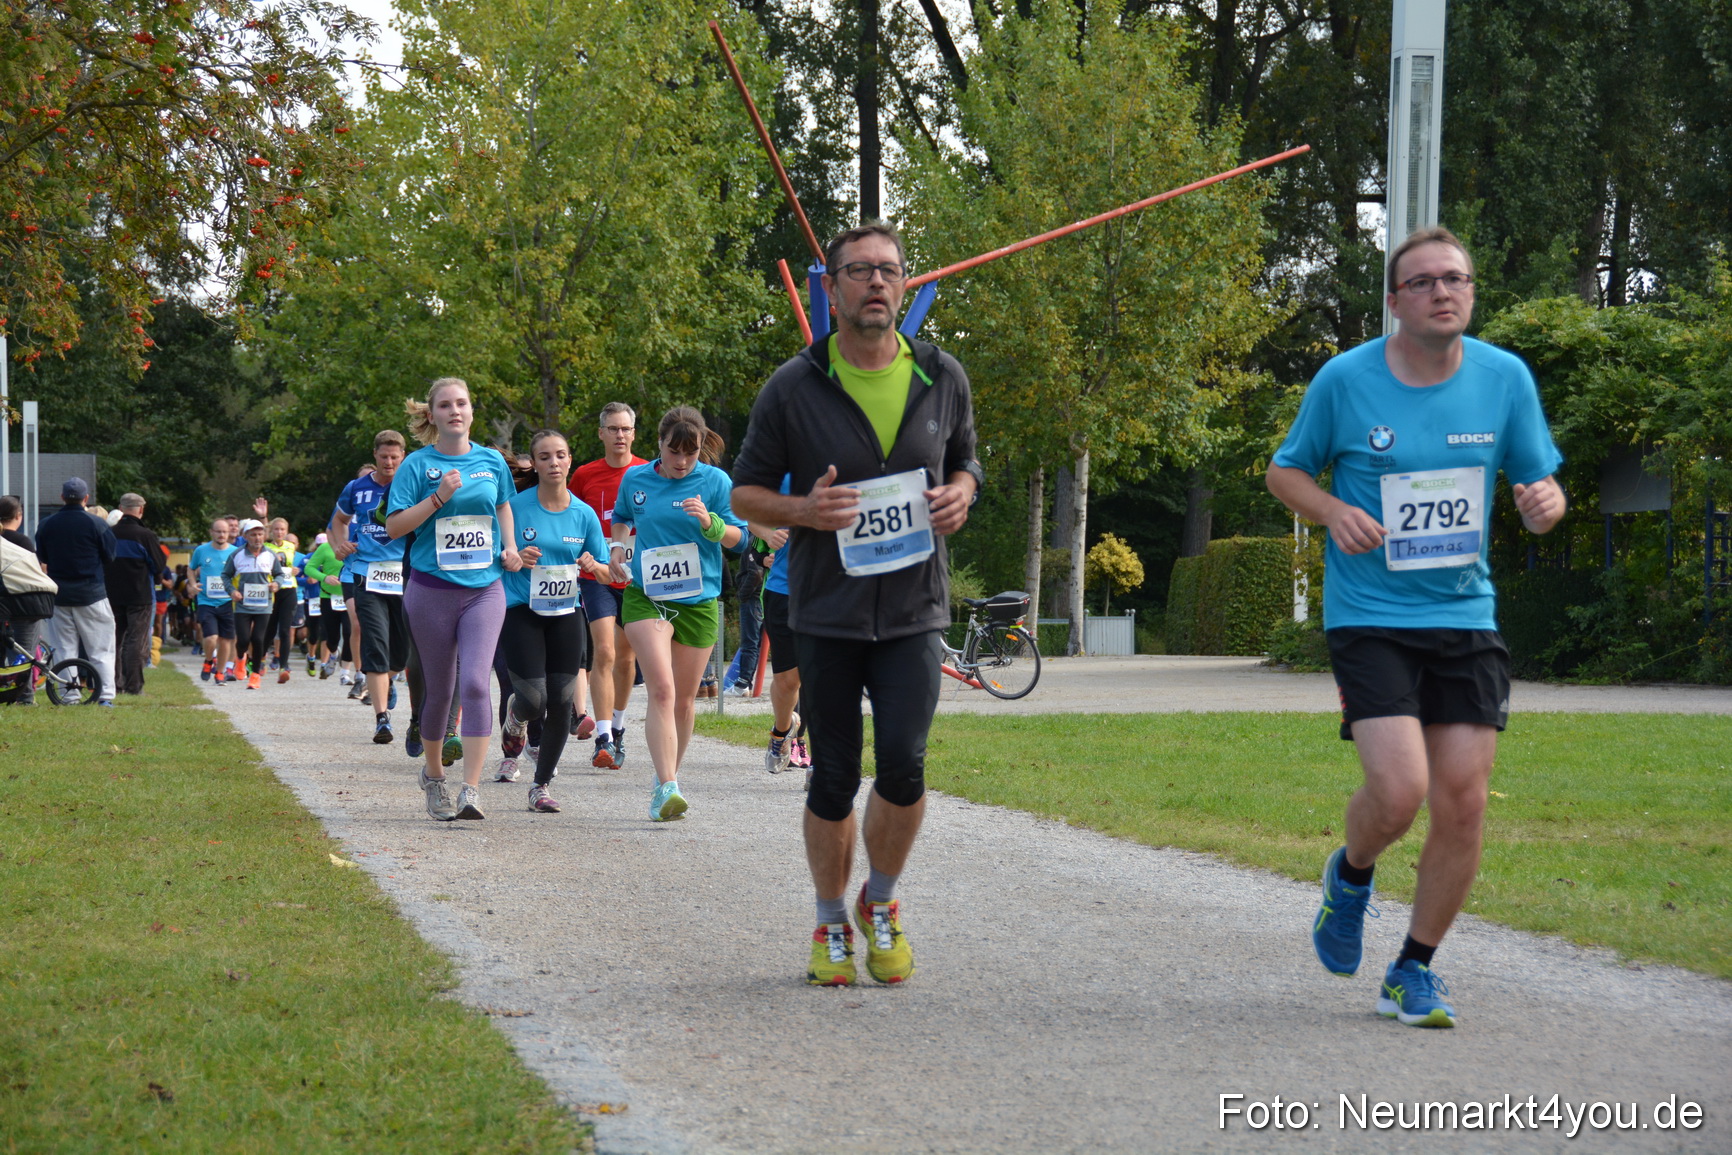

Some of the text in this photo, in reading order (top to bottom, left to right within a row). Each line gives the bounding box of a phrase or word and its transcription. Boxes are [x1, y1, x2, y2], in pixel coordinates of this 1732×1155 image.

[1446, 432, 1495, 445] BOCK
[1421, 478, 1456, 488] BOCK
[355, 490, 373, 504] 11
[868, 485, 900, 496] BOCK
[853, 501, 913, 539] 2581
[1398, 498, 1470, 532] 2792
[445, 531, 485, 549] 2426
[562, 536, 584, 544] BOCK
[874, 542, 904, 556] Martin
[1390, 539, 1464, 558] Thomas
[460, 553, 473, 561] Nina
[372, 570, 401, 582] 2086
[650, 560, 690, 581] 2441
[538, 580, 572, 596] 2027
[663, 583, 683, 591] Sophie
[247, 590, 266, 598] 2210
